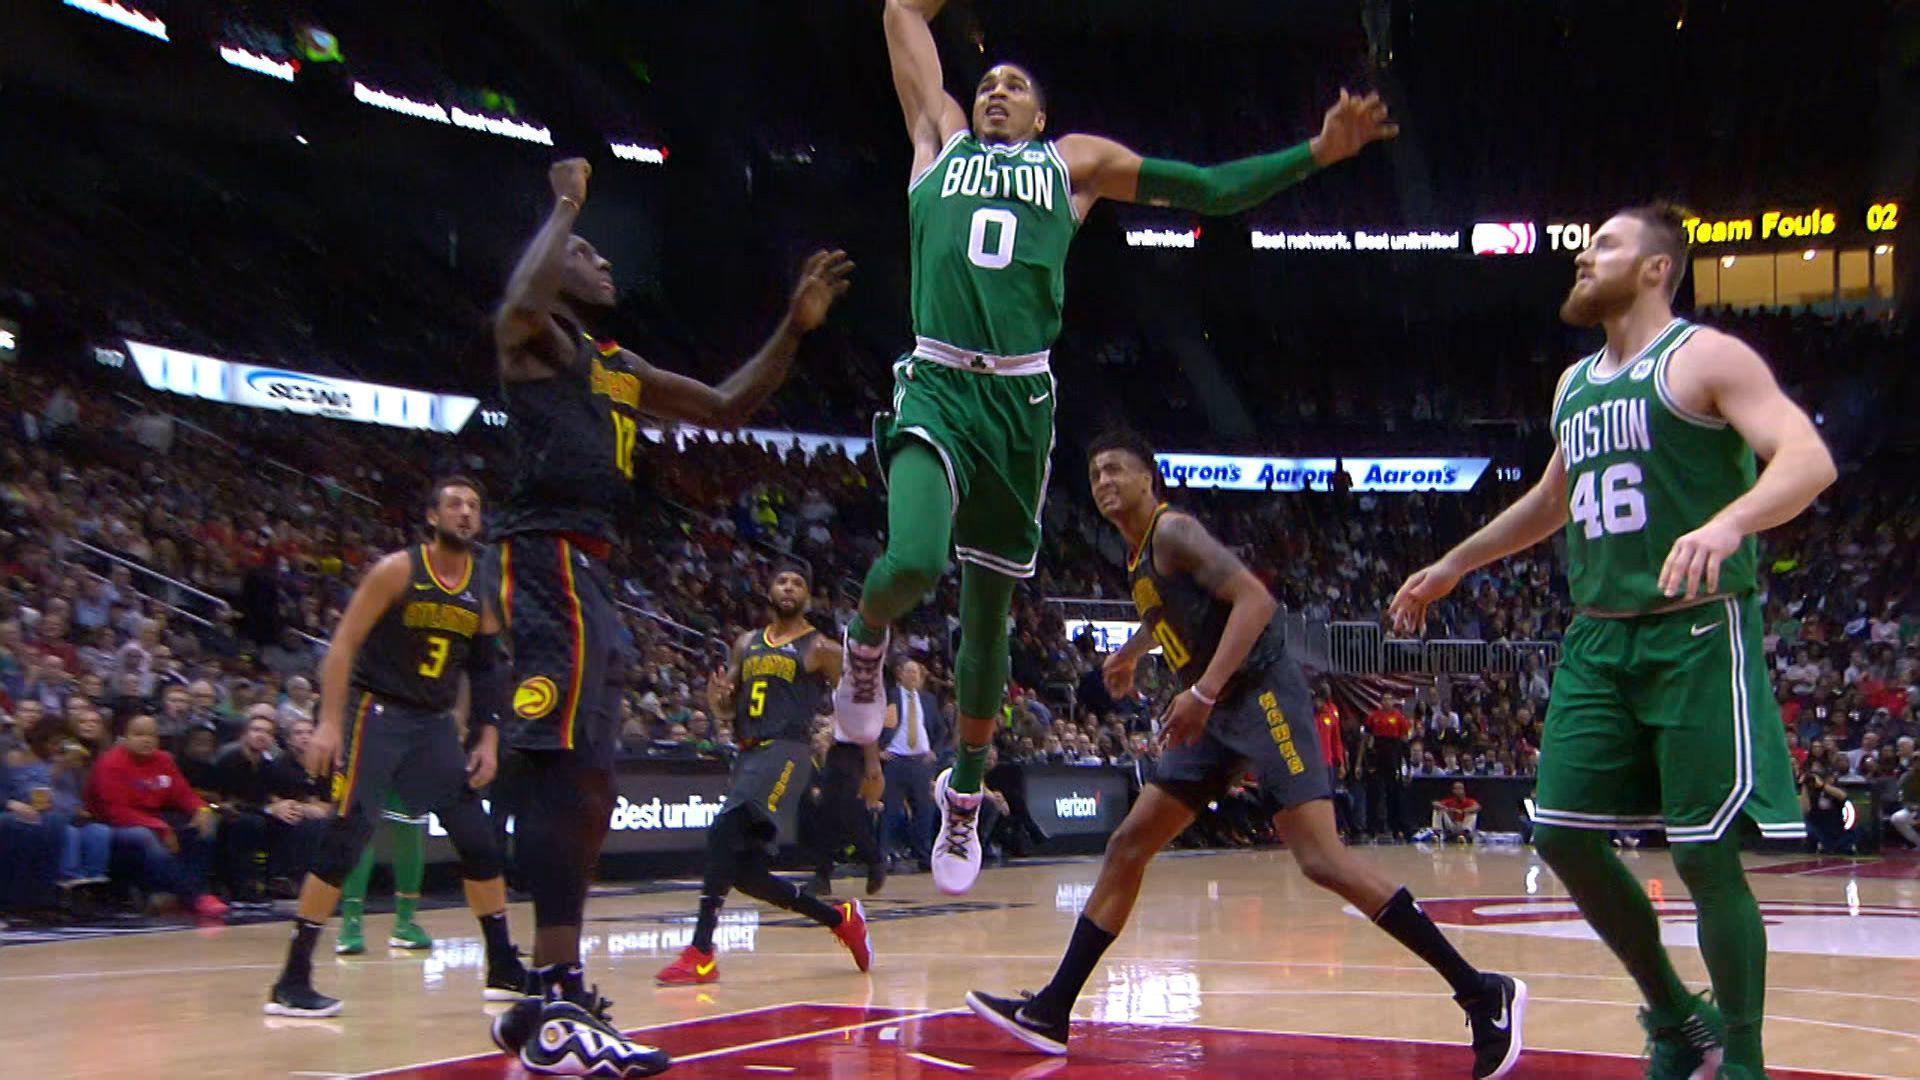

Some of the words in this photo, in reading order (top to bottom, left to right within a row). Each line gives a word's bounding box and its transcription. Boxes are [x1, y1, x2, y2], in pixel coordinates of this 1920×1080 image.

[941, 153, 1053, 211] BOSTON
[967, 207, 1017, 269] 0
[1682, 217, 1752, 244] Team
[1762, 208, 1835, 239] Fouls
[1867, 203, 1897, 231] 02
[1560, 398, 1651, 472] BOSTON
[1158, 459, 1242, 482] Aaron's
[1363, 463, 1460, 485] Aaron's
[1569, 462, 1648, 540] 46
[418, 636, 450, 679] 3
[749, 681, 768, 717] 5
[610, 795, 661, 830] Best
[1055, 791, 1097, 817] verizon
